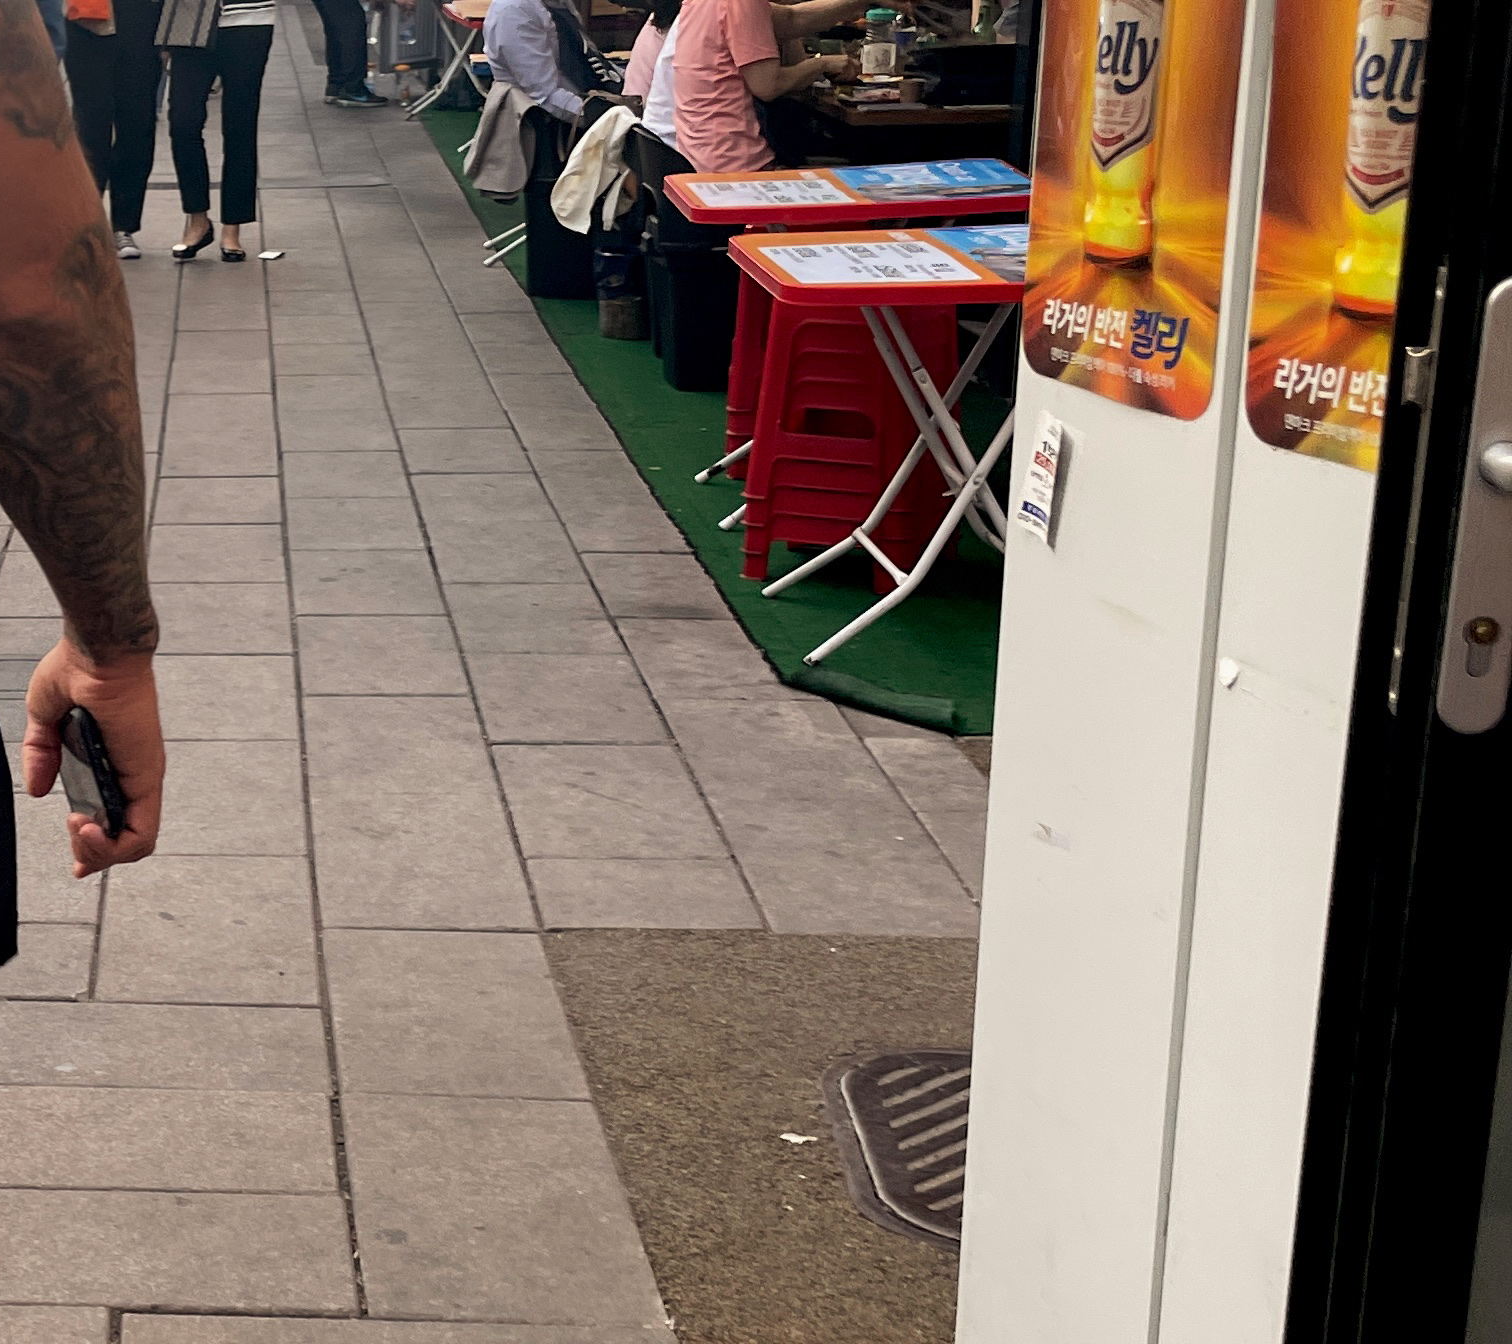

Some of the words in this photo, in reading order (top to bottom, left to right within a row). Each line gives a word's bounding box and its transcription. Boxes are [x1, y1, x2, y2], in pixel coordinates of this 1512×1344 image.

[1096, 21, 1159, 95] elly
[1042, 298, 1094, 341] 라거의
[1093, 307, 1129, 350] 반전
[1130, 308, 1191, 370] 켈리
[1273, 357, 1347, 409] 라거의
